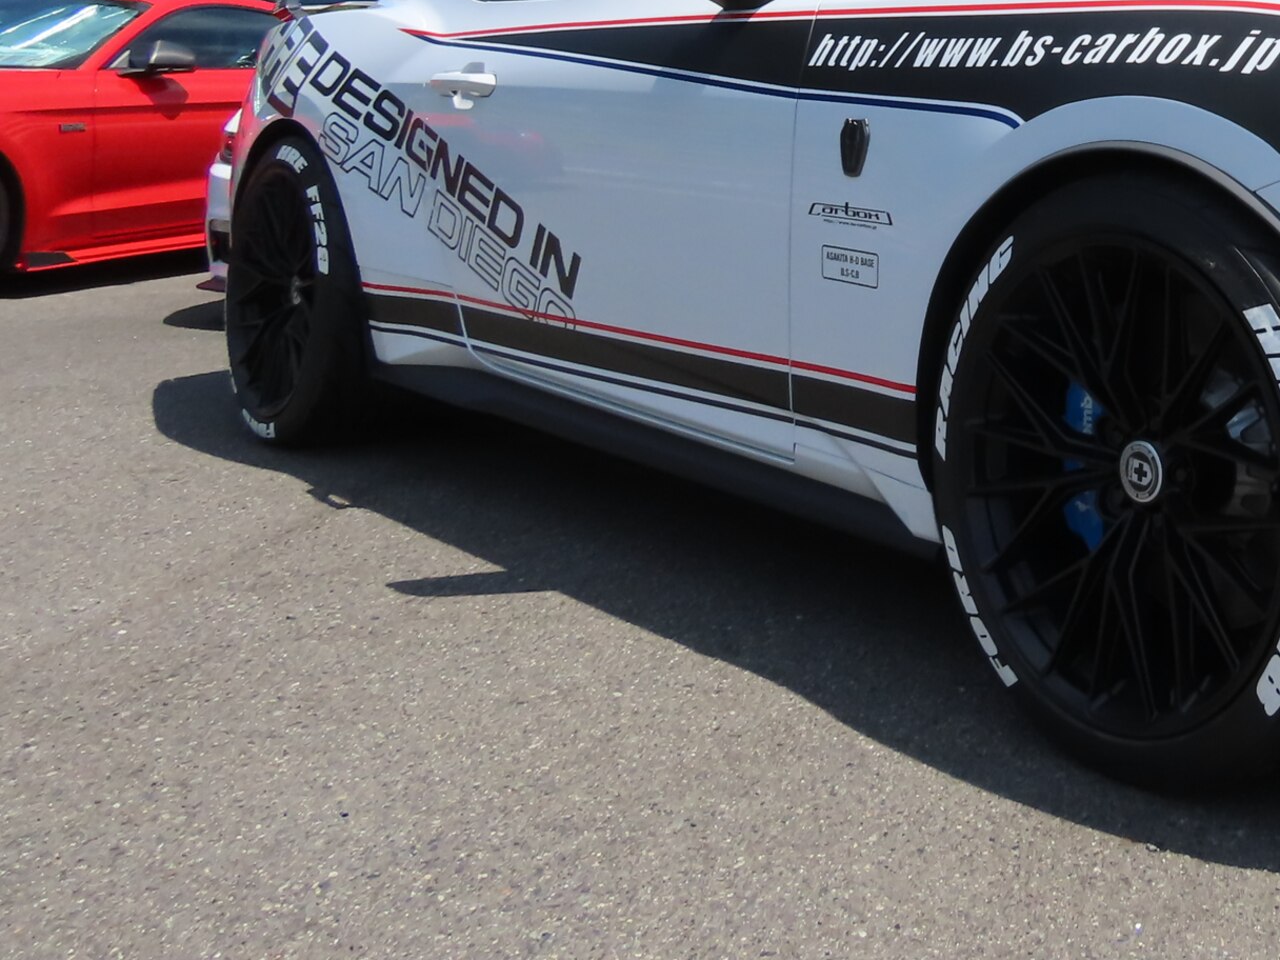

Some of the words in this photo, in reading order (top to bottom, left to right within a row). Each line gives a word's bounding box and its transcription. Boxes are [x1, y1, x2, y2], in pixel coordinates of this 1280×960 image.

[275, 144, 309, 175] HRE
[310, 50, 524, 249] DESIGNED
[530, 223, 582, 300] IN
[318, 111, 427, 218] SAN
[427, 189, 576, 330] DIEGO
[934, 234, 1015, 462] RACING
[942, 524, 1019, 688] FORD
